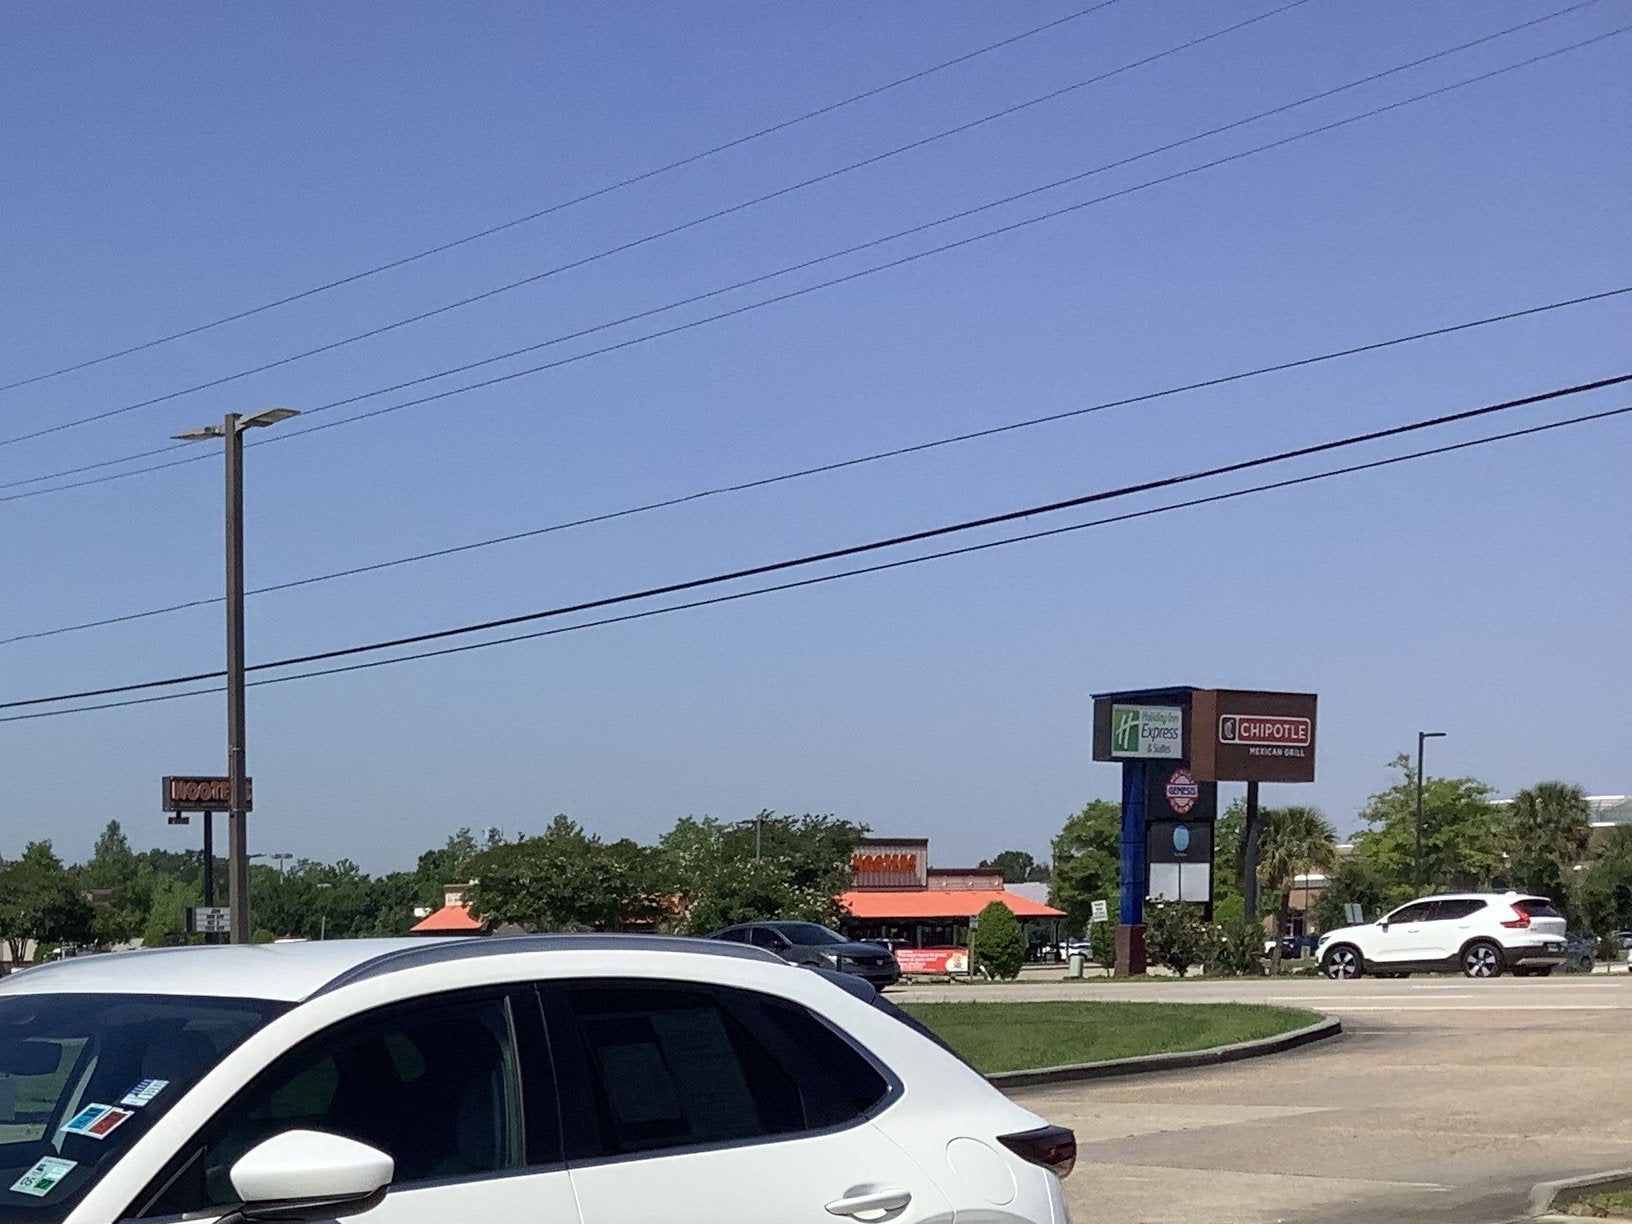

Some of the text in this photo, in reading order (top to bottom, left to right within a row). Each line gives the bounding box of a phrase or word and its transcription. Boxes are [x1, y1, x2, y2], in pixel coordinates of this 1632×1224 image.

[1141, 723, 1179, 742] Express
[1240, 722, 1307, 739] CHIPOTLE
[1249, 747, 1305, 757] MEXICAN GRILL
[171, 780, 252, 800] HOOTES
